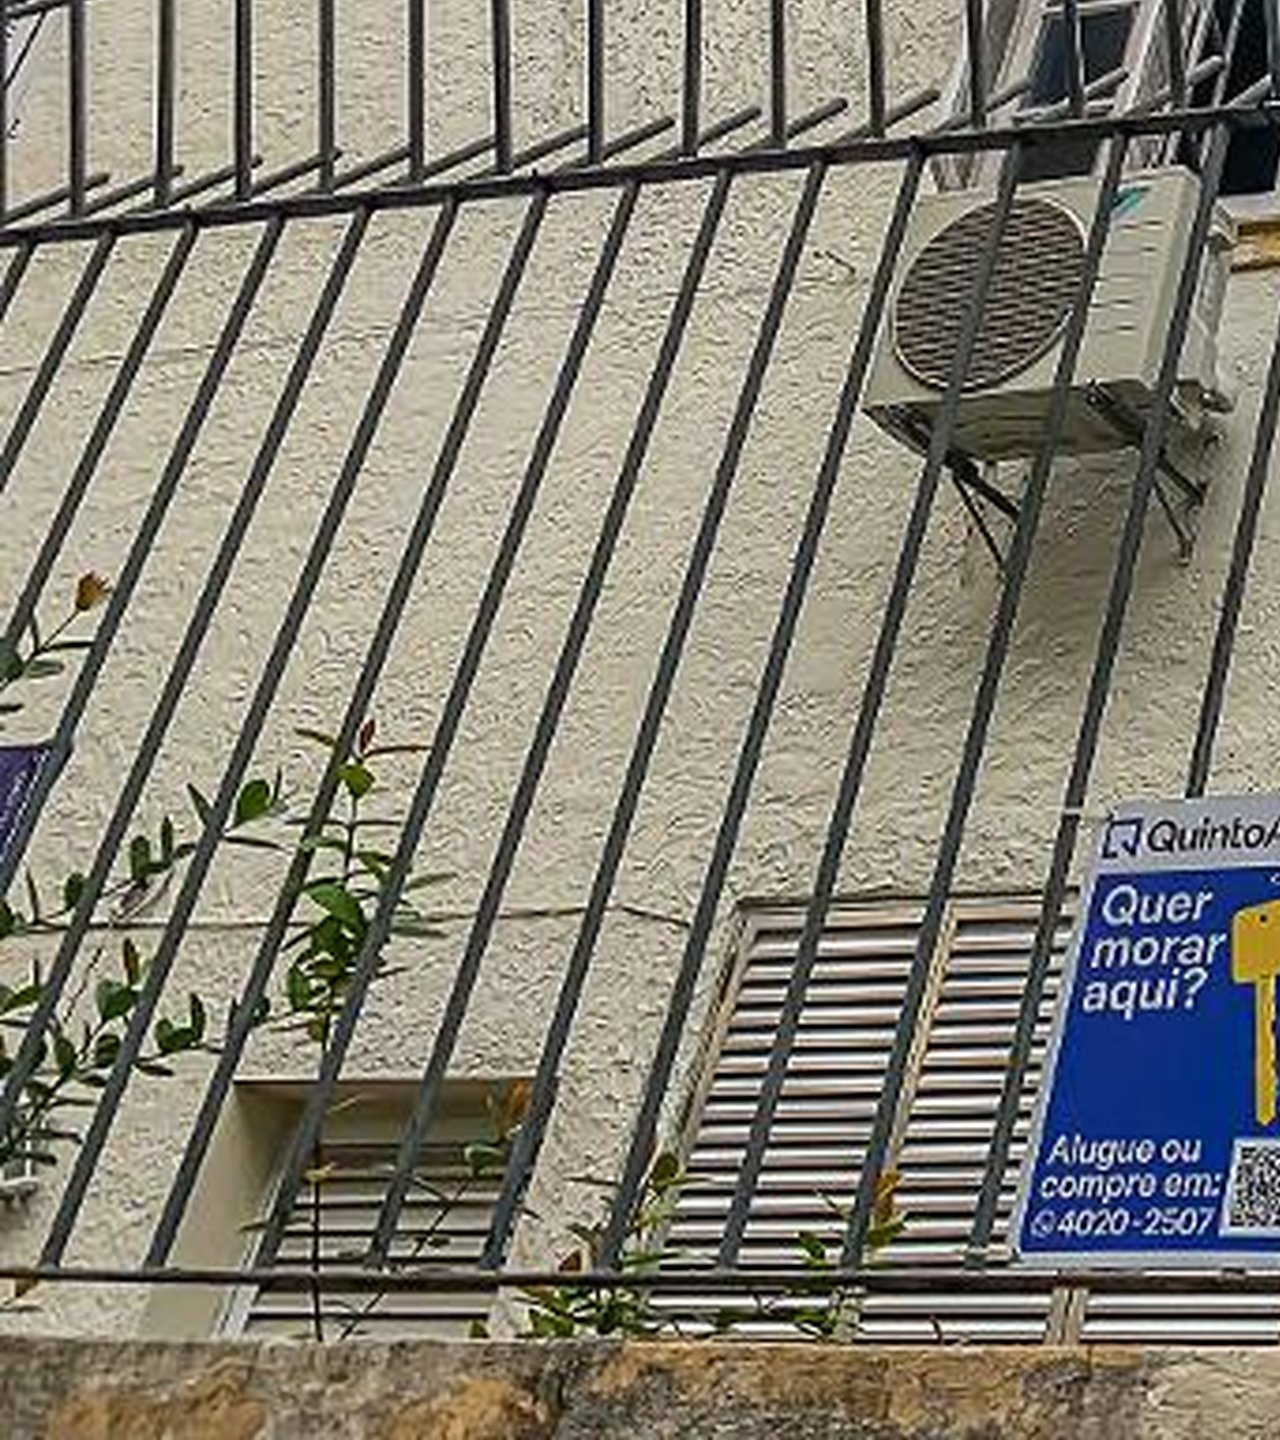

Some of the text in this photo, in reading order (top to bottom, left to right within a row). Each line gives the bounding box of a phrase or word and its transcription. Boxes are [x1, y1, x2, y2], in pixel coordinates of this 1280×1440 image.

[1102, 884, 1213, 926] Quer
[1091, 933, 1227, 968] morar
[1083, 967, 1208, 1021] aqui?
[1046, 1134, 1201, 1172] Alugue ou
[1041, 1172, 1223, 1205] compre em:
[1057, 1207, 1217, 1236] 4020-2507
